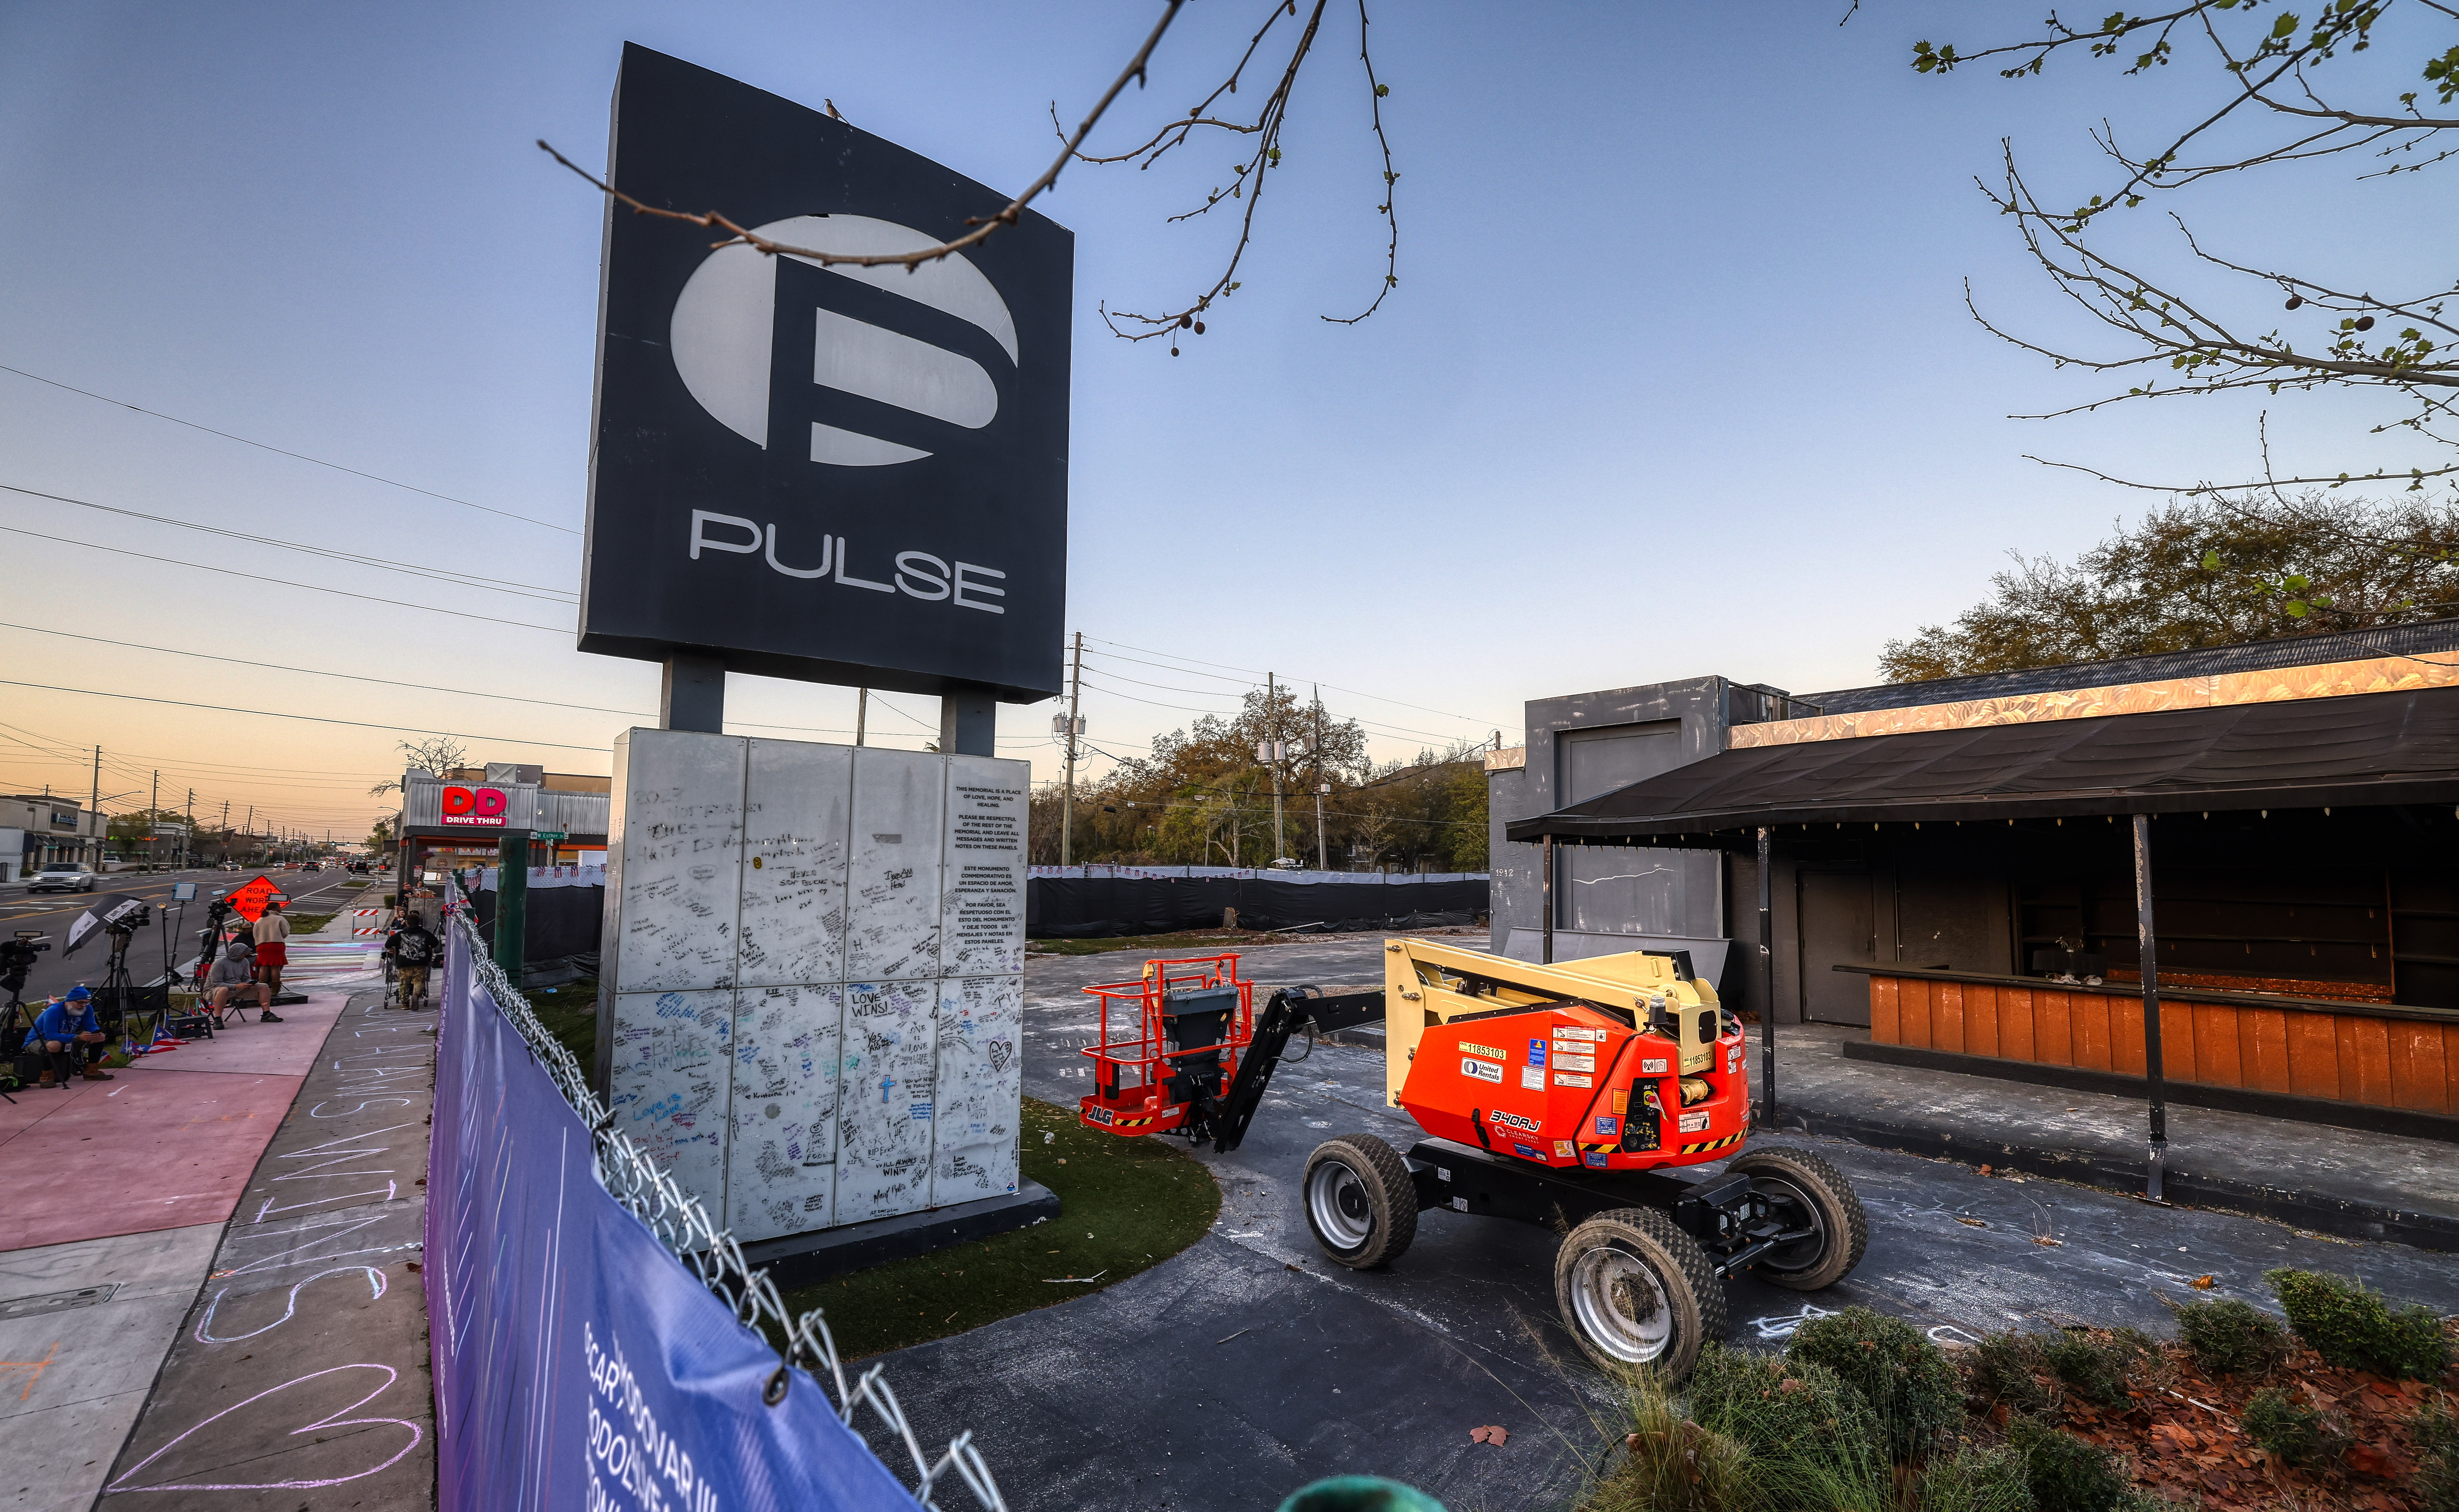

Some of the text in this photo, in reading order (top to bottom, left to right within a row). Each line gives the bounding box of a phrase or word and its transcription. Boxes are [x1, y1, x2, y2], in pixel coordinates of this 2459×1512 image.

[690, 508, 1006, 614] PULSE
[443, 787, 507, 816] DD
[790, 870, 817, 879] NEVER
[852, 993, 881, 1004] LOVE
[852, 1001, 888, 1017] WINS!
[868, 1032, 882, 1047] Yes
[909, 1042, 928, 1054] LOVE
[1468, 1044, 1504, 1059] 11853103
[1690, 1052, 1711, 1066] 11853103
[1478, 1071, 1499, 1080] Rentals
[1479, 1064, 1498, 1073] United
[633, 1101, 666, 1121] Love
[656, 1103, 684, 1122] Love
[1087, 1105, 1114, 1126] JLG
[840, 1118, 852, 1130] LOVE
[1489, 1110, 1541, 1132] 340AJ
[1506, 1129, 1538, 1141] CLEARSKY
[868, 1148, 879, 1157] RIP
[895, 1157, 917, 1166] ALWAYS
[883, 1168, 901, 1176] WIN!
[195, 1122, 415, 1344] WINS
